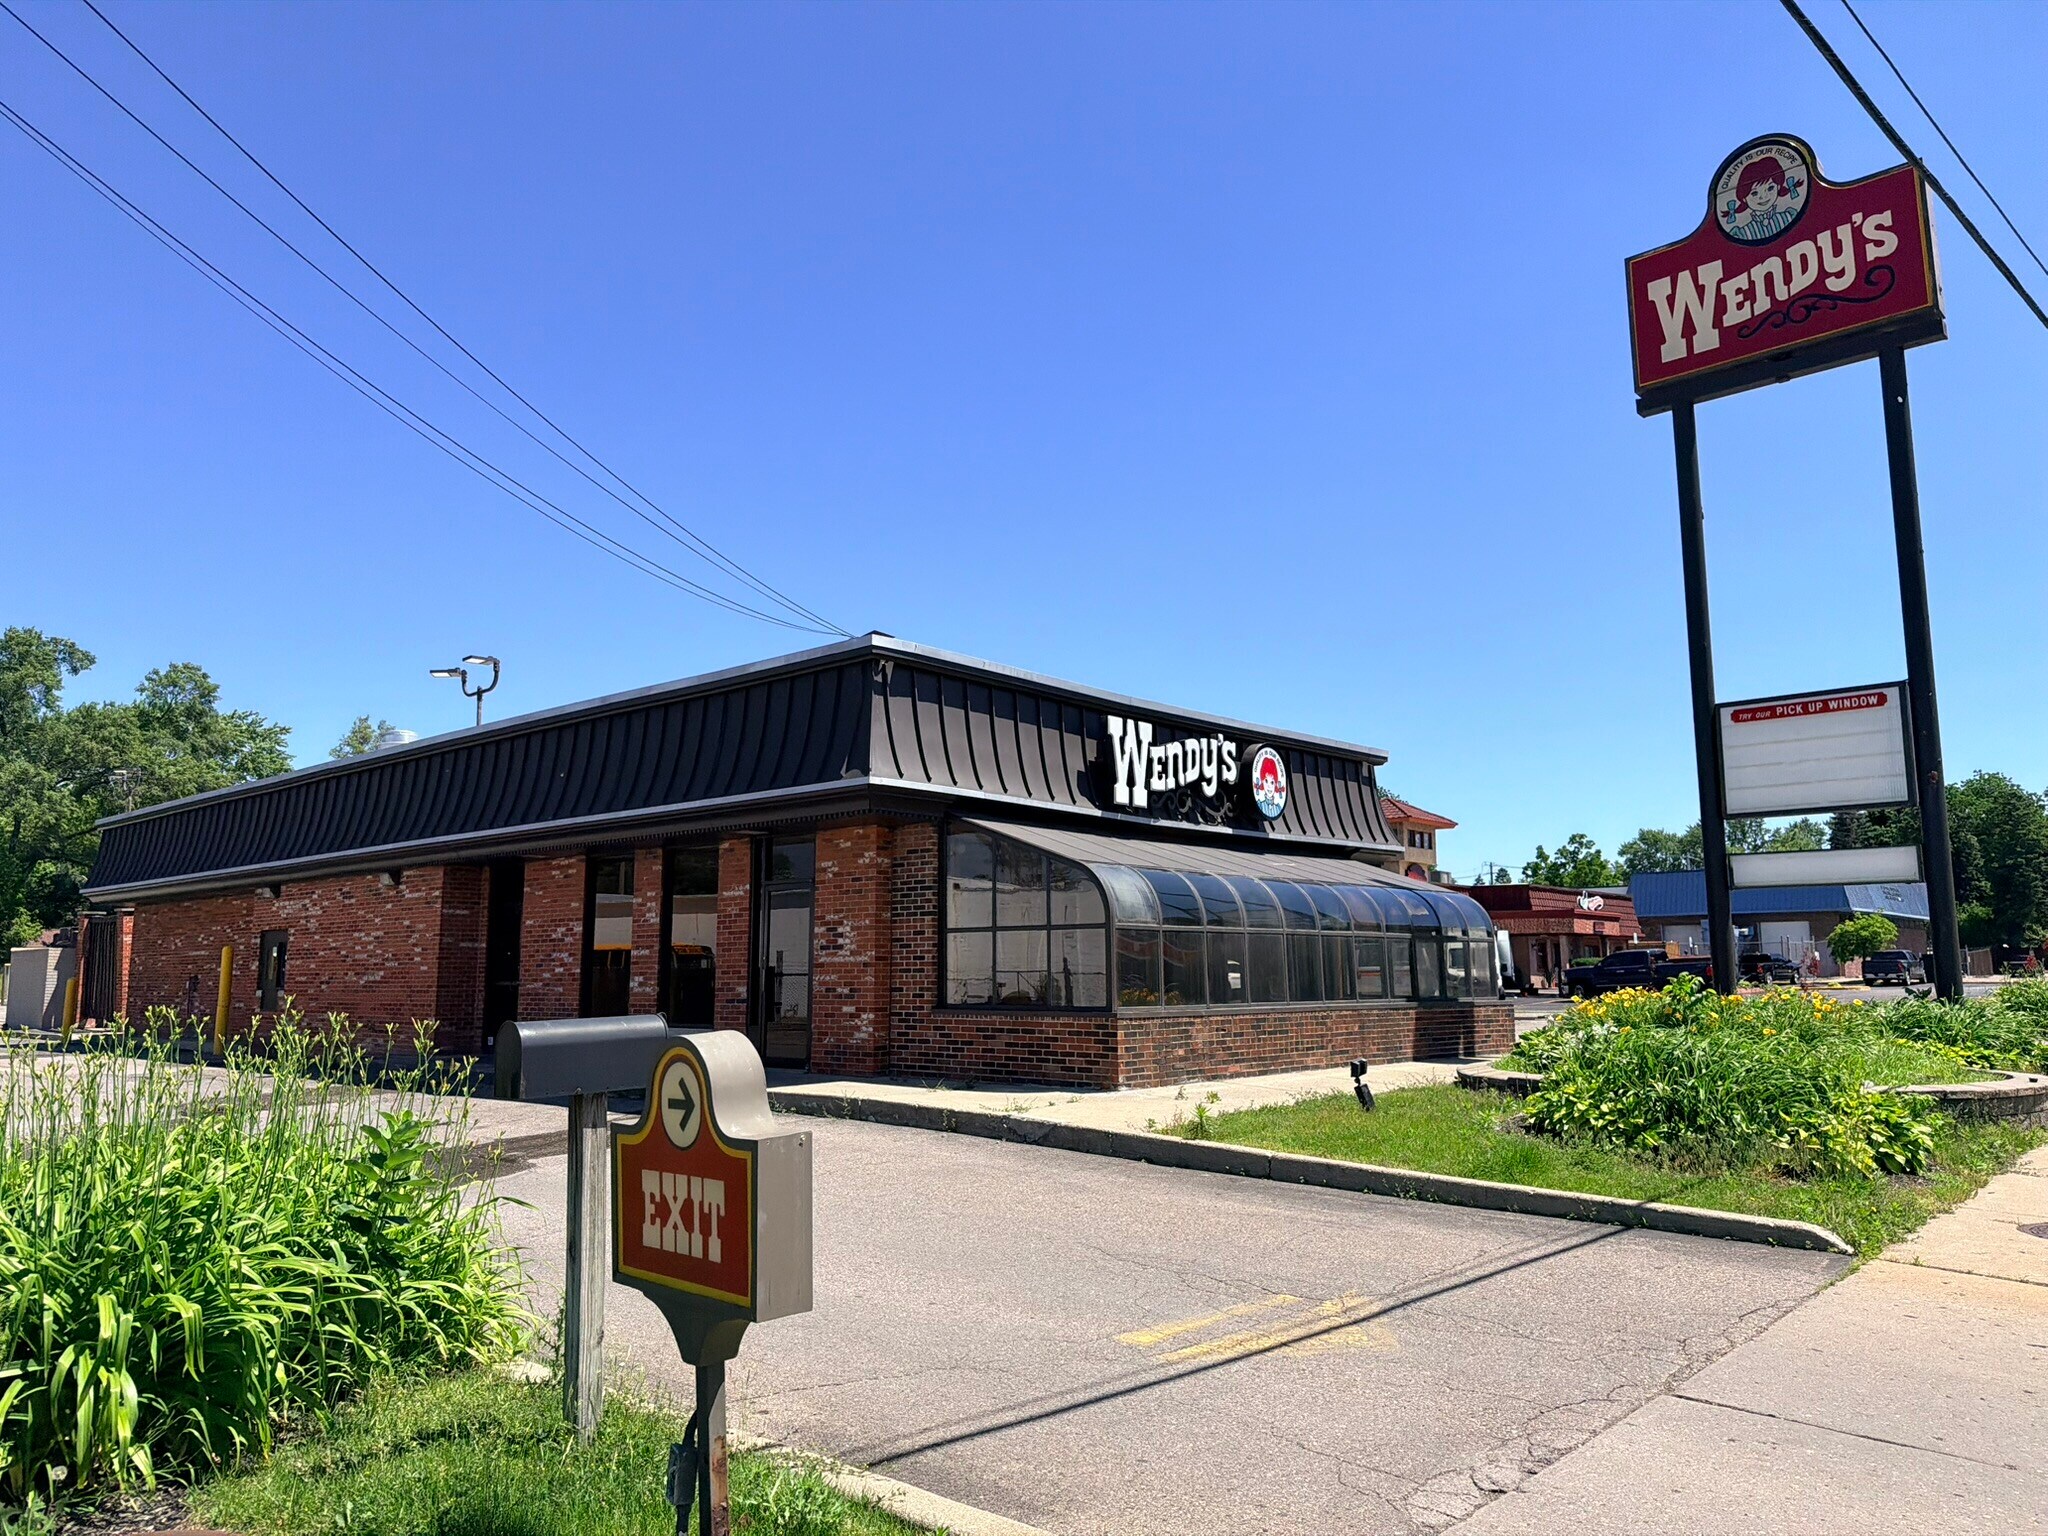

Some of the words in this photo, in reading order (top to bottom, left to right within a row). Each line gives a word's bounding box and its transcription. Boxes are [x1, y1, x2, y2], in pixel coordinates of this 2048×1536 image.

[1721, 160, 1744, 190] QUALITY
[1745, 153, 1753, 161] IS
[1756, 147, 1773, 156] OUR
[1774, 147, 1798, 165] RECIPE
[1647, 209, 1899, 364] Wendy's
[1738, 713, 1753, 721] TRY
[1755, 710, 1771, 719] OUR
[1776, 703, 1804, 716] PICK
[1808, 701, 1824, 713] UP
[1827, 694, 1879, 710] WINDOW
[1107, 714, 1238, 810] Wendy's
[641, 1168, 726, 1264] EXIT
